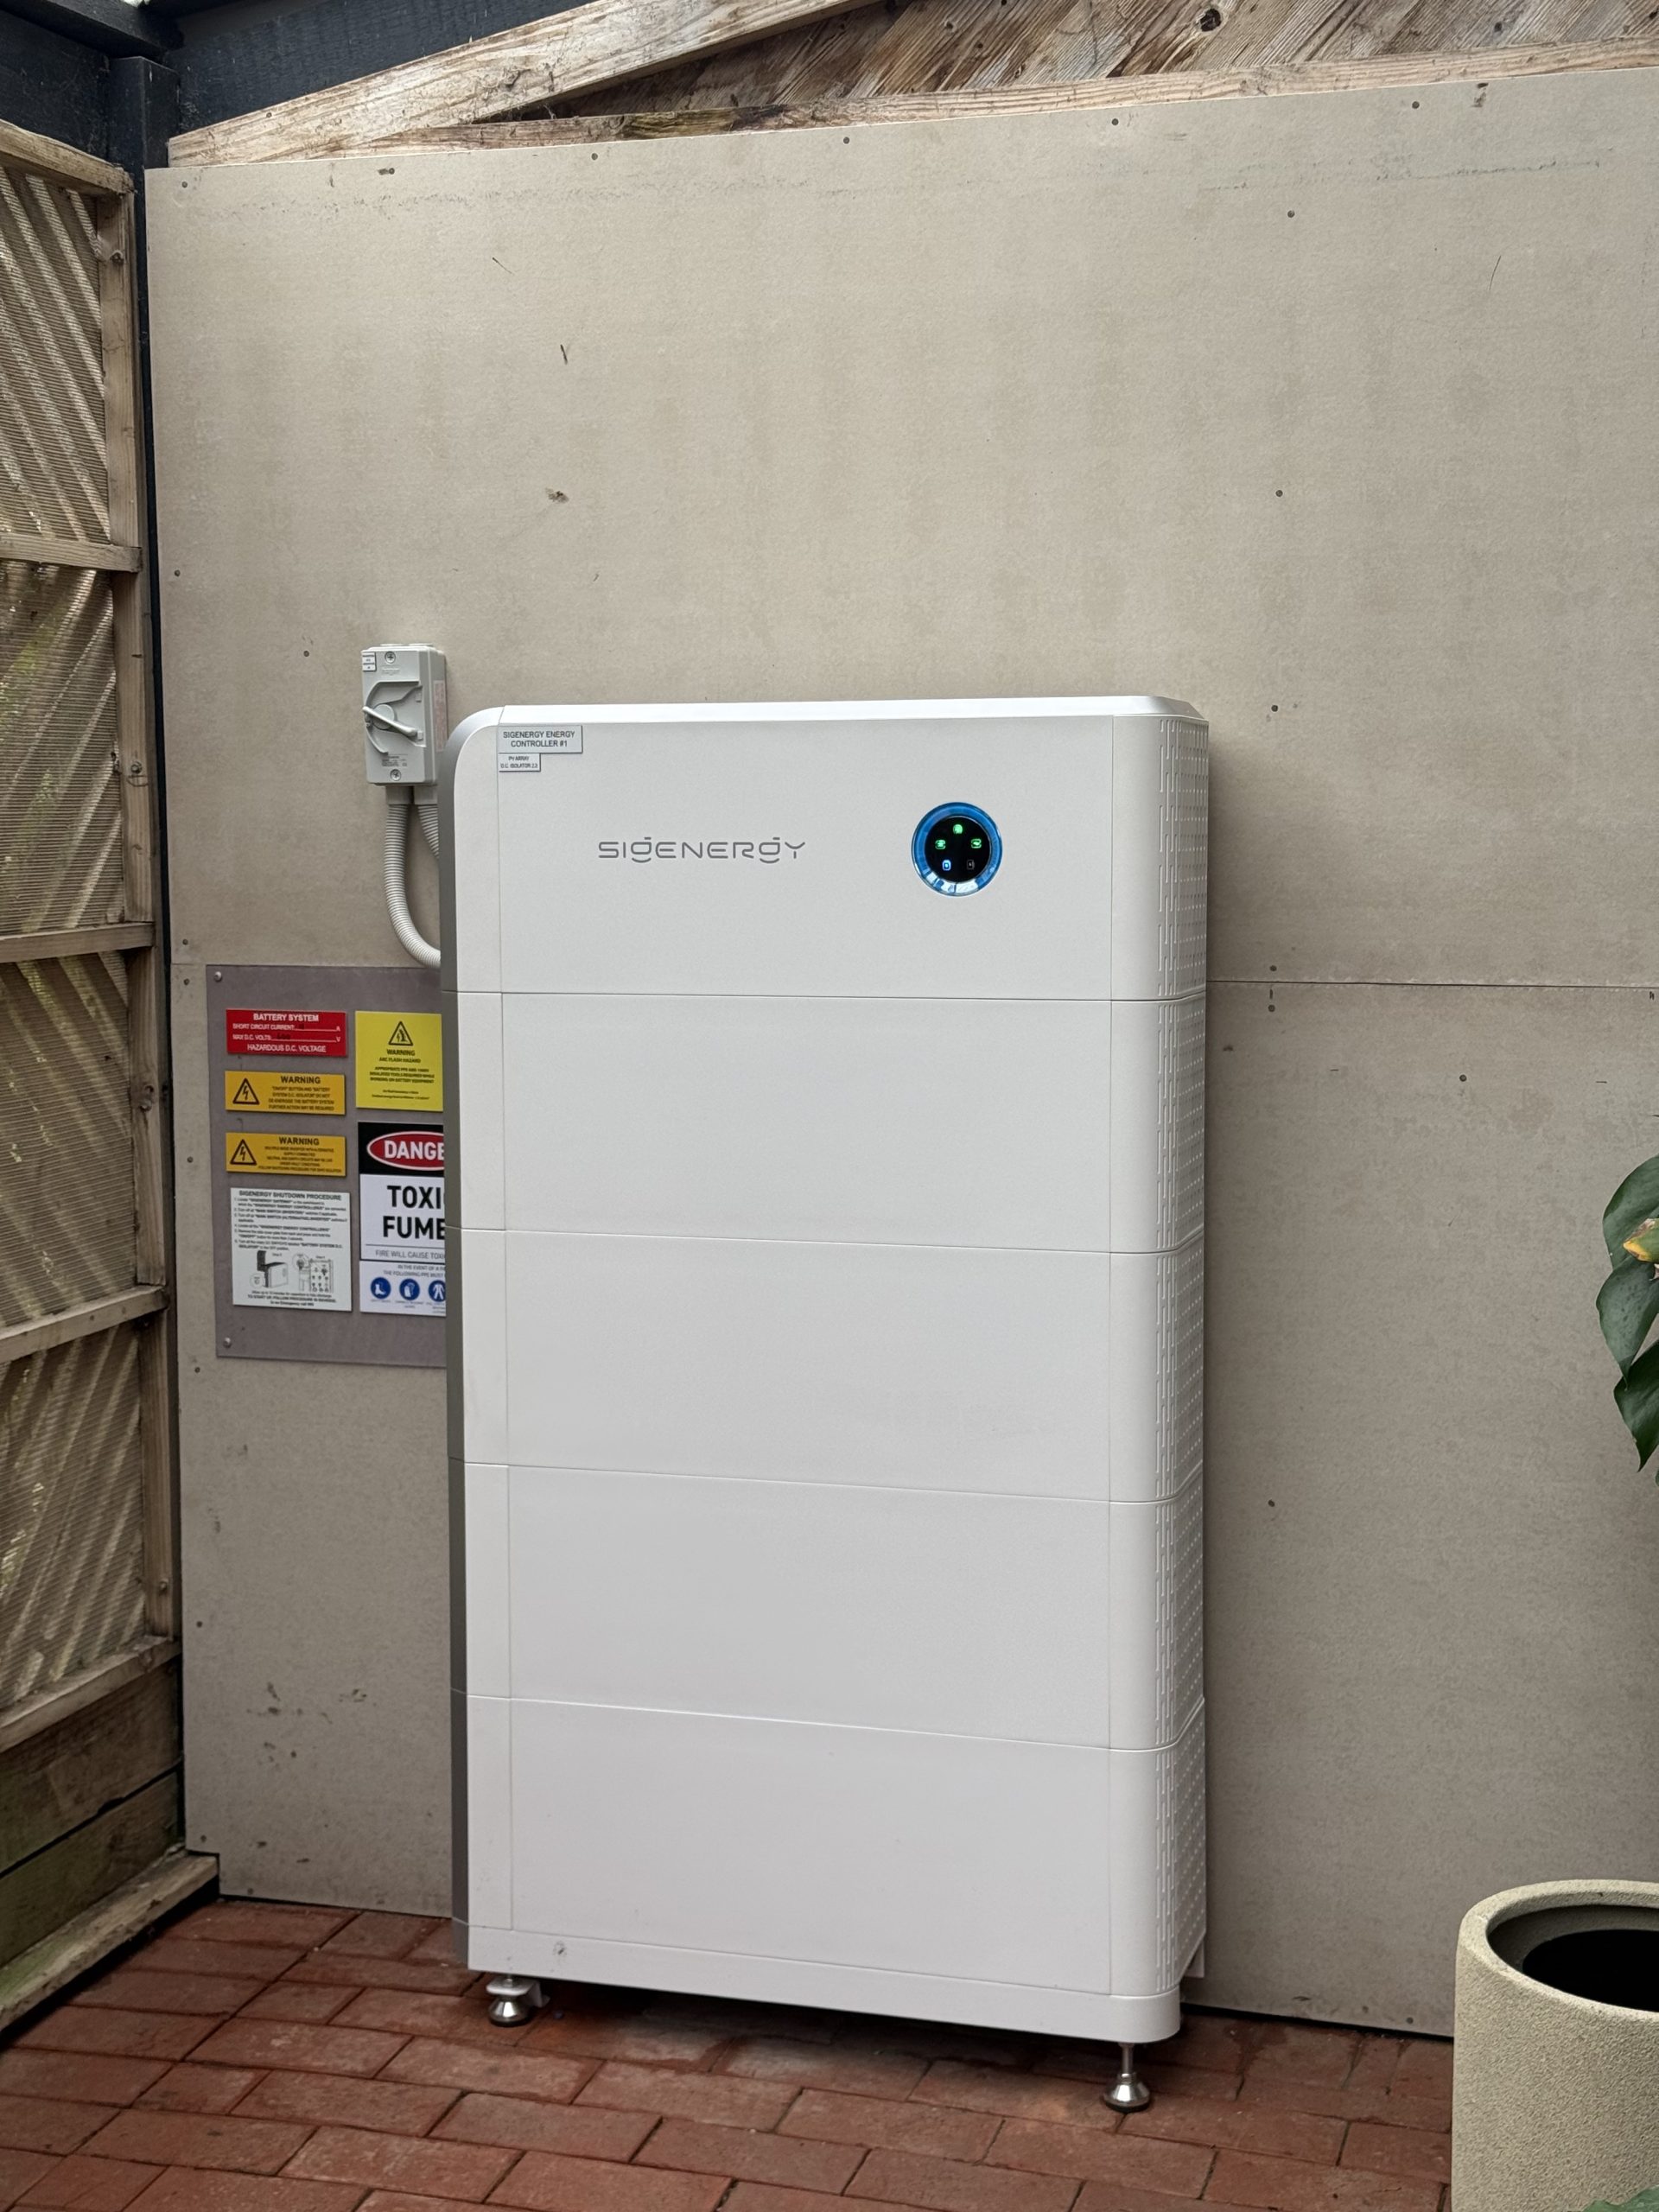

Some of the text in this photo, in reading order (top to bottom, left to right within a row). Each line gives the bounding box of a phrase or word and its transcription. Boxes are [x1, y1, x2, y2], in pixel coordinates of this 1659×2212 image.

[253, 1013, 320, 1022] BATTERY SYSTEM
[299, 1045, 327, 1053] VOLTAGE
[280, 1076, 321, 1084] WARNING
[278, 1136, 320, 1146] WARNING
[384, 1140, 444, 1161] DANGE
[386, 1185, 444, 1210] TOXI
[383, 1215, 445, 1241] FUME
